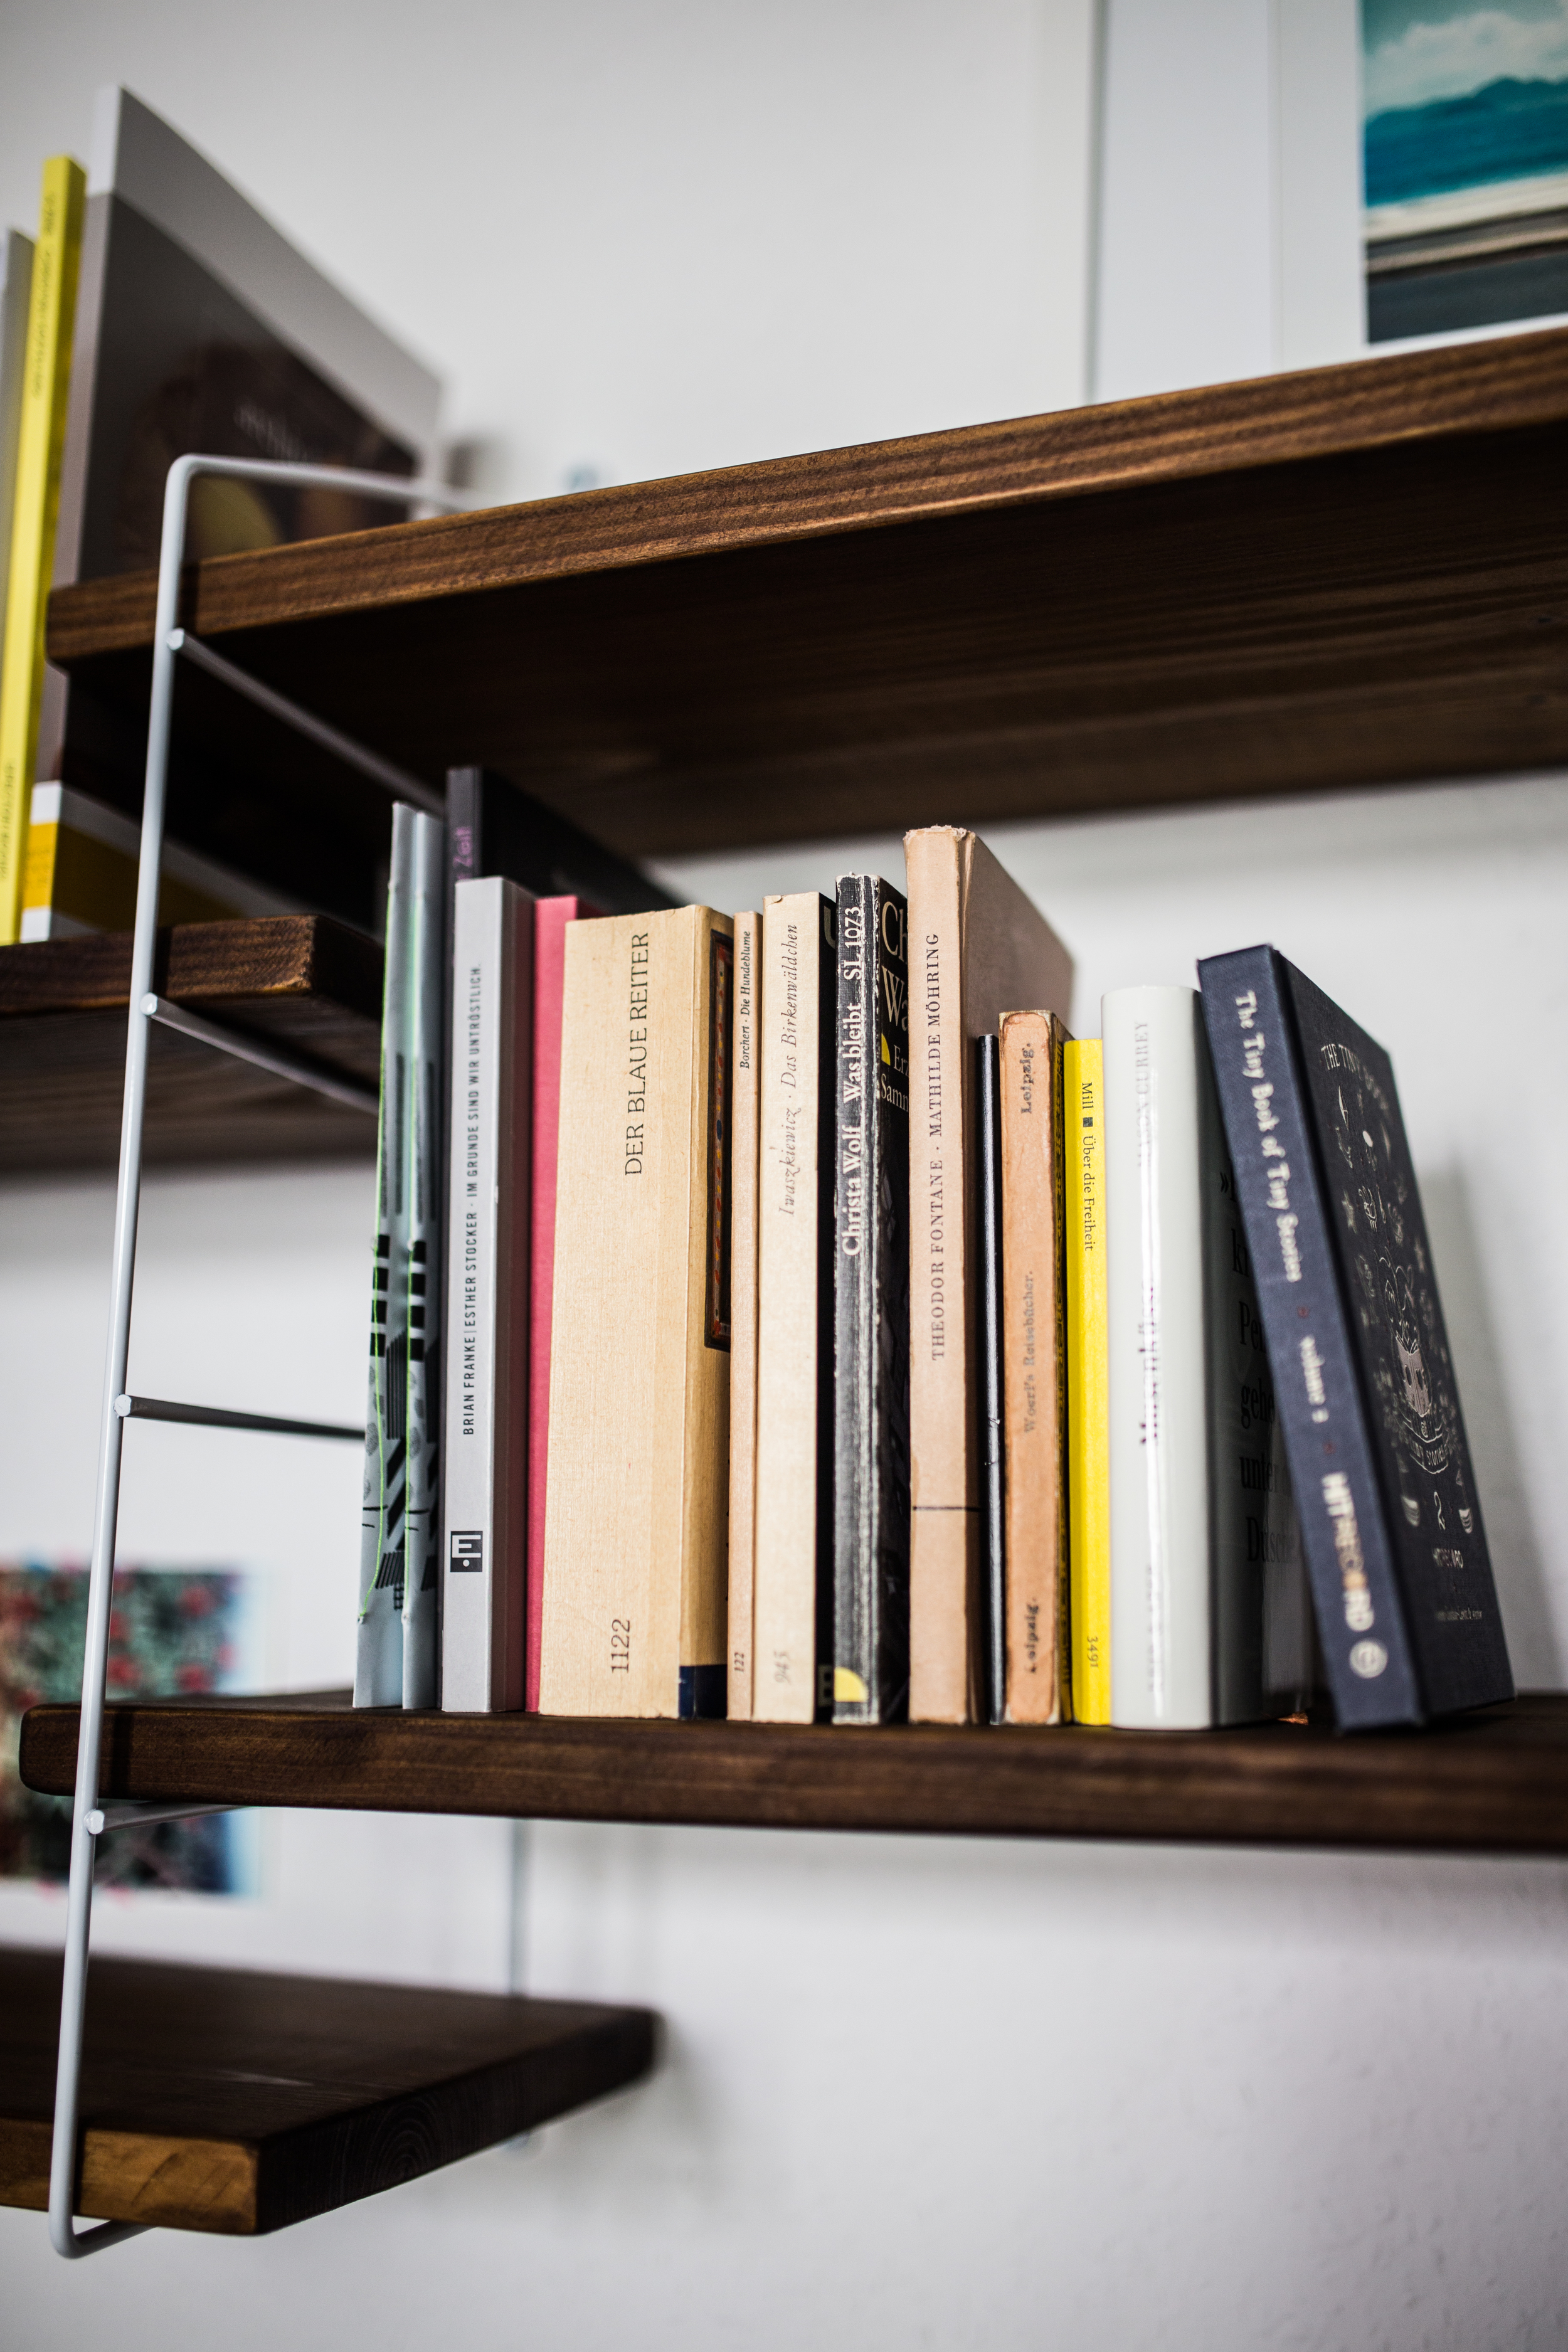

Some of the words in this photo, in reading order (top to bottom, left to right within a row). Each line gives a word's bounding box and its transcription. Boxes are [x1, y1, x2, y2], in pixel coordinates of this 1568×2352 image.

[844, 906, 862, 949] 1073
[630, 932, 648, 1022] REITER
[740, 931, 751, 996] Hundeblume
[781, 924, 799, 1049] Birkenwäldchen
[926, 933, 940, 1027] MÖHRING
[467, 963, 481, 1056] UNTRÖSTLICH.
[740, 999, 751, 1016] Die
[842, 1003, 862, 1060] bleibt
[1235, 989, 1258, 1029] The
[627, 1027, 647, 1113] BLAUE
[739, 1025, 750, 1069] Borchert
[781, 1054, 797, 1089] Das
[1135, 1021, 1149, 1094] CURREY
[1242, 1032, 1266, 1079] Tiny
[1321, 1044, 1340, 1070] THE
[469, 1059, 479, 1086] WIR
[842, 1061, 861, 1104] Was
[928, 1034, 942, 1138] MATHILDE
[1082, 1082, 1093, 1109] Mill
[468, 1090, 479, 1120] SIND
[1251, 1083, 1280, 1132] Book
[467, 1125, 479, 1177] GRUNDE
[625, 1123, 644, 1175] DER
[779, 1107, 802, 1217] Iwaszkiewicz
[842, 1125, 861, 1174] Wolf
[1083, 1135, 1096, 1167] Über
[1261, 1135, 1286, 1158] of
[467, 1182, 477, 1197] IM
[930, 1160, 943, 1254] FONTANE
[1084, 1172, 1096, 1193] die
[1266, 1161, 1291, 1210] Tiny
[466, 1212, 477, 1270] STOCKER
[842, 1177, 861, 1256] Christa
[1084, 1197, 1096, 1252] Freiheit
[1276, 1212, 1303, 1283] Stories
[465, 1277, 476, 1327] ESTHER
[931, 1261, 945, 1361] THEODOR
[464, 1337, 475, 1388] FRANKE
[463, 1394, 474, 1435] BRIAN
[610, 1619, 630, 1673] 1122
[734, 1651, 744, 1673] 122
[1087, 1635, 1099, 1668] 3491
